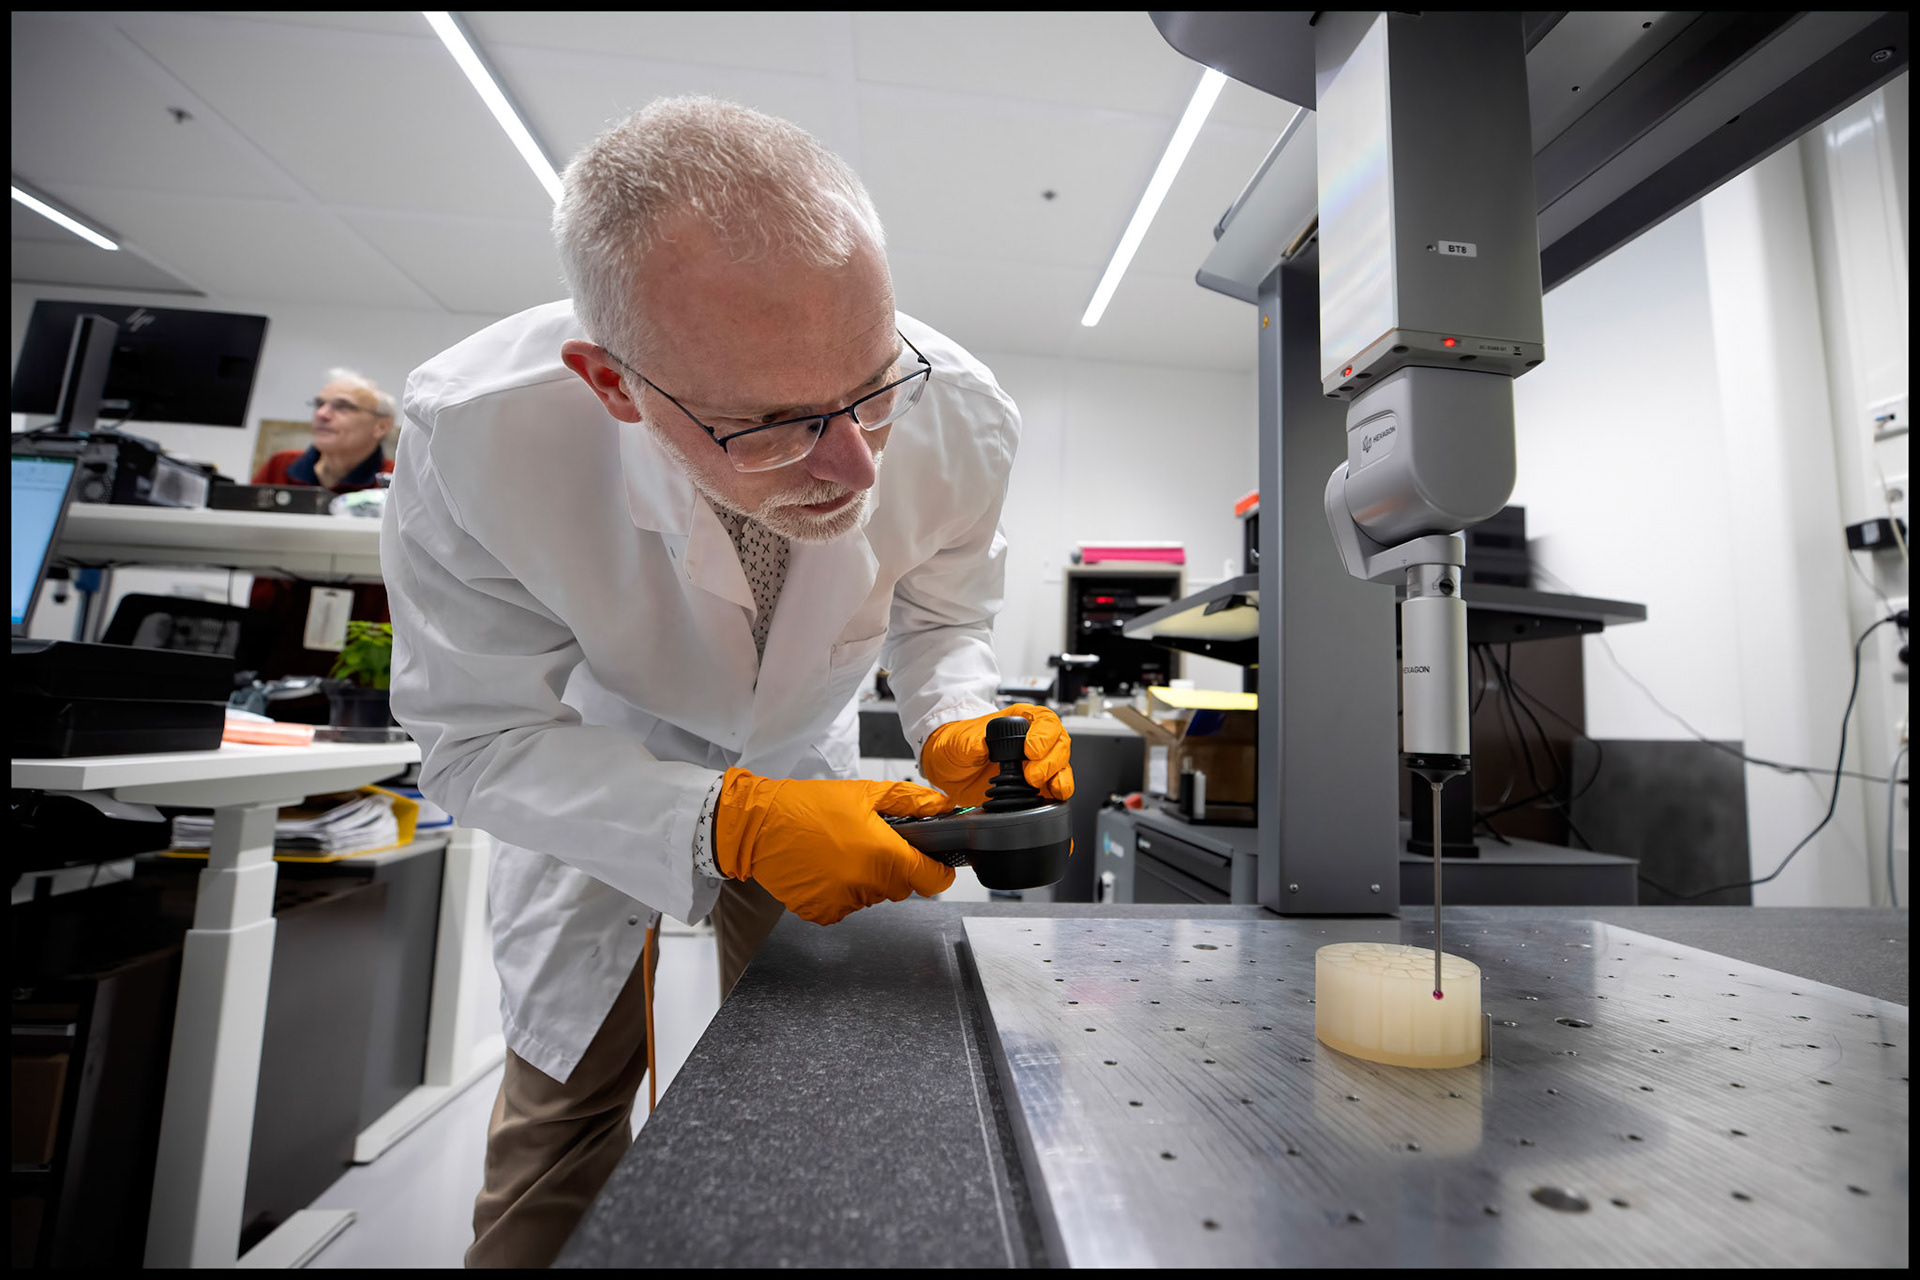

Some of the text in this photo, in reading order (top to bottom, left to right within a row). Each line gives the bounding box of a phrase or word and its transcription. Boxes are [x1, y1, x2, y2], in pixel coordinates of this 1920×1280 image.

[1448, 244, 1468, 254] BT8
[1373, 426, 1396, 443] HEXAGON
[1403, 666, 1430, 674] EXAGON
